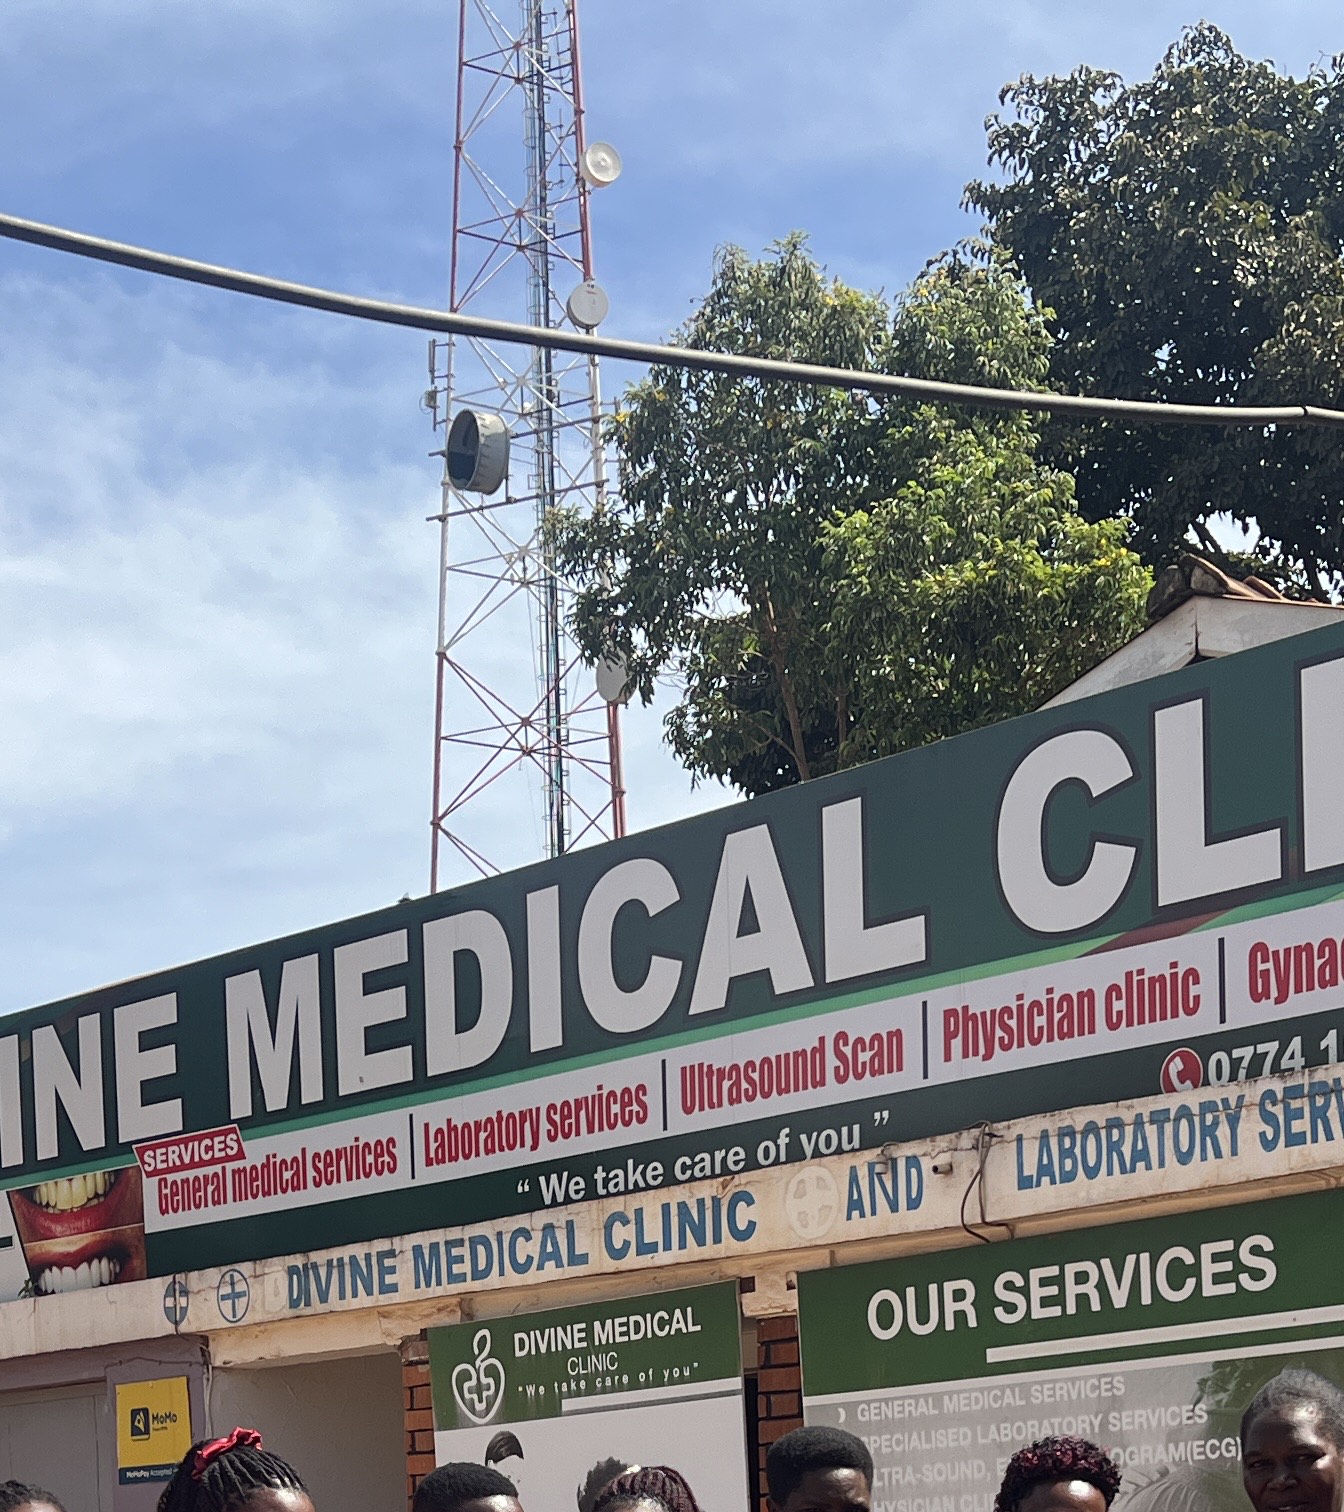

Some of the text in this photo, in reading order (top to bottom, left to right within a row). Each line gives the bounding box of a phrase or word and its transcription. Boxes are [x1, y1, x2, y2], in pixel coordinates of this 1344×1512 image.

[224, 797, 927, 1121] MEDICAL
[942, 960, 1202, 1062] Physician clinic
[679, 1027, 905, 1116] Ultrasound Scan
[1207, 1034, 1306, 1086] 0774
[423, 1083, 649, 1167] Laboratory services
[142, 1132, 239, 1172] SERVICES
[158, 1136, 398, 1217] General medical services
[594, 1157, 664, 1197] take
[673, 1146, 746, 1181] care
[757, 1127, 793, 1164] of
[798, 1123, 861, 1162] you
[287, 1248, 399, 1309] DIVINE
[412, 1219, 590, 1291] MEDICAL
[602, 1190, 757, 1262] CLINIC
[845, 1153, 924, 1222] AND
[1016, 1094, 1246, 1191] LABORATORY
[866, 1234, 1278, 1341] OUR SERVICES
[514, 1306, 702, 1358] DIVINE MEDICAL
[553, 1378, 587, 1393] take
[595, 1373, 629, 1388] care
[638, 1367, 654, 1382] of
[567, 1351, 618, 1376] CLINIC
[151, 1411, 178, 1425] MoMo
[857, 1376, 1126, 1422] GENERAL MEDICAL SERVICES
[861, 1403, 1209, 1455] SPECIALISED LABORATORY SERVICES
[873, 1458, 992, 1488] LTRA-SOUND,
